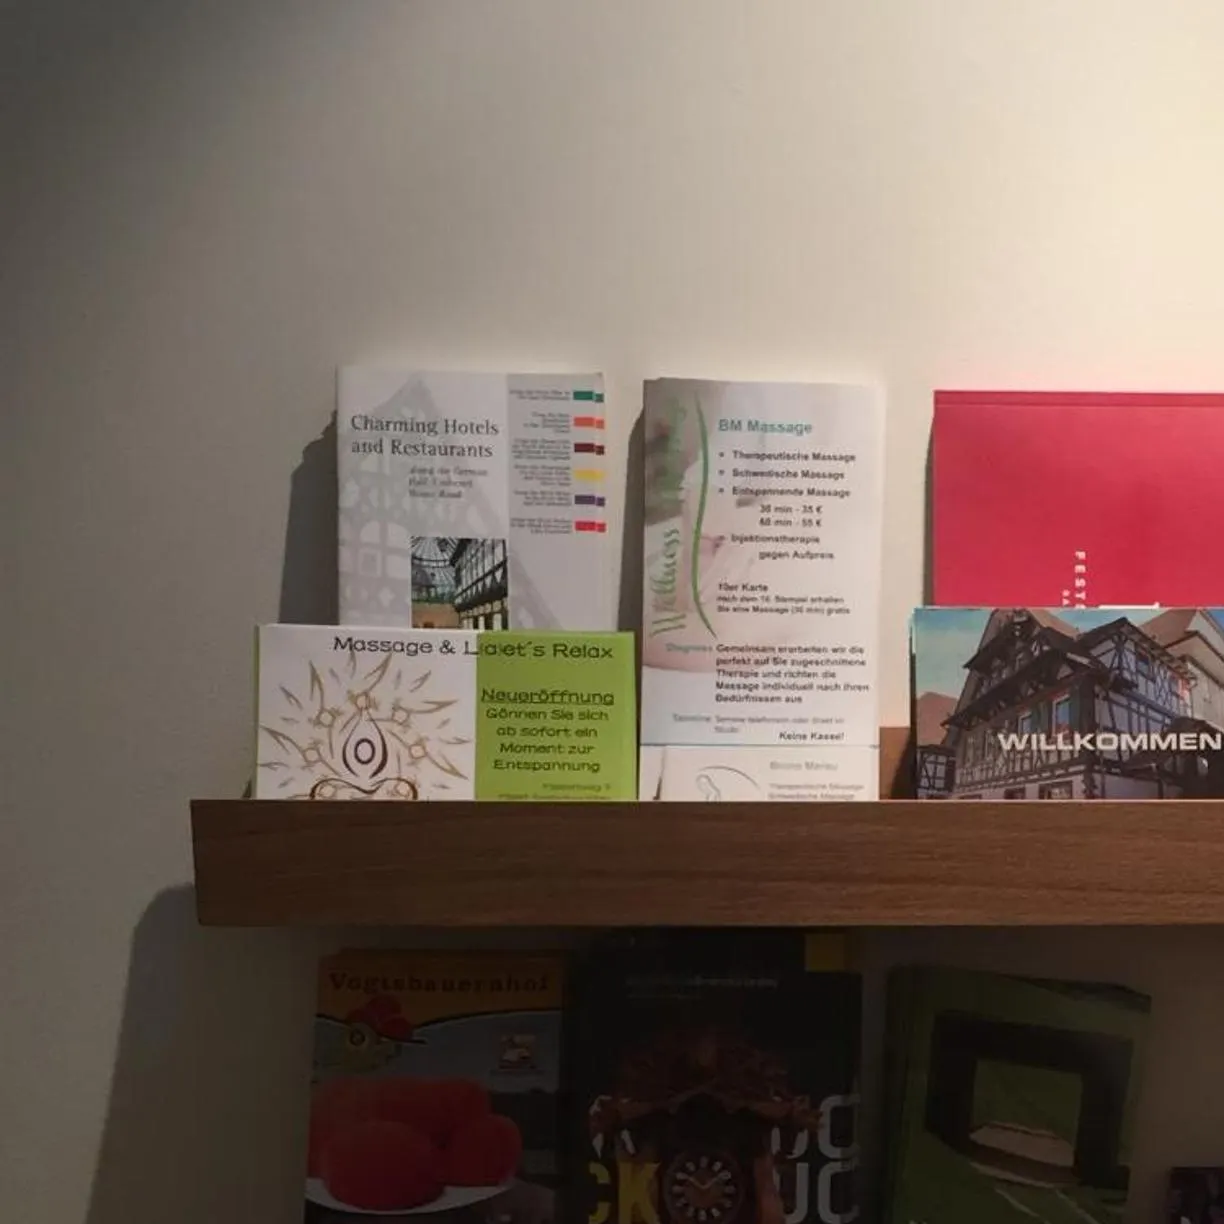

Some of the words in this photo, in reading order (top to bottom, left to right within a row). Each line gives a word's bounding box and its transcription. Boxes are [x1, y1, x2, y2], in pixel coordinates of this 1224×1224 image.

[350, 415, 439, 437] Charming
[443, 418, 500, 437] Hotels
[718, 418, 742, 432] BM
[747, 419, 813, 436] Massage
[351, 440, 384, 455] and
[390, 440, 494, 459] Restaurants
[732, 450, 809, 463] Therapeutische
[812, 452, 856, 464] Massage
[732, 468, 799, 480] Schwedische
[801, 469, 845, 481] Massage
[732, 485, 804, 498] Entspannende
[807, 487, 851, 499] Massage
[774, 504, 793, 514] min
[774, 517, 793, 527] min
[758, 551, 791, 562] gegen
[742, 582, 769, 593] Karte
[752, 604, 789, 616] Massage
[334, 636, 434, 656] Massage
[439, 639, 457, 654] &
[552, 643, 614, 659] Relax
[716, 642, 776, 654] Gemeinsam
[848, 644, 865, 655] die
[716, 656, 751, 667] perfekt
[753, 656, 771, 666] auf
[772, 656, 788, 666] Sie
[716, 668, 759, 680] Therapie
[762, 669, 782, 679] und
[784, 669, 819, 680] richten
[821, 670, 836, 680] die
[716, 681, 760, 693] Massage
[762, 681, 814, 692] individuell
[816, 682, 841, 693] nach
[480, 687, 616, 706] Neueröffnung
[784, 696, 803, 705] aus
[485, 708, 546, 722] Gönnen
[550, 709, 576, 721] Sie
[578, 709, 609, 722] sich
[496, 724, 517, 737] ab
[520, 724, 571, 738] sofort
[574, 726, 598, 737] ein
[778, 731, 807, 742] Keine
[499, 742, 565, 755] Moment
[567, 745, 596, 755] zur
[998, 732, 1222, 752] WILLKOMMEN
[493, 759, 601, 774] Entspannung
[329, 970, 550, 995] Vogtsbauernhof
